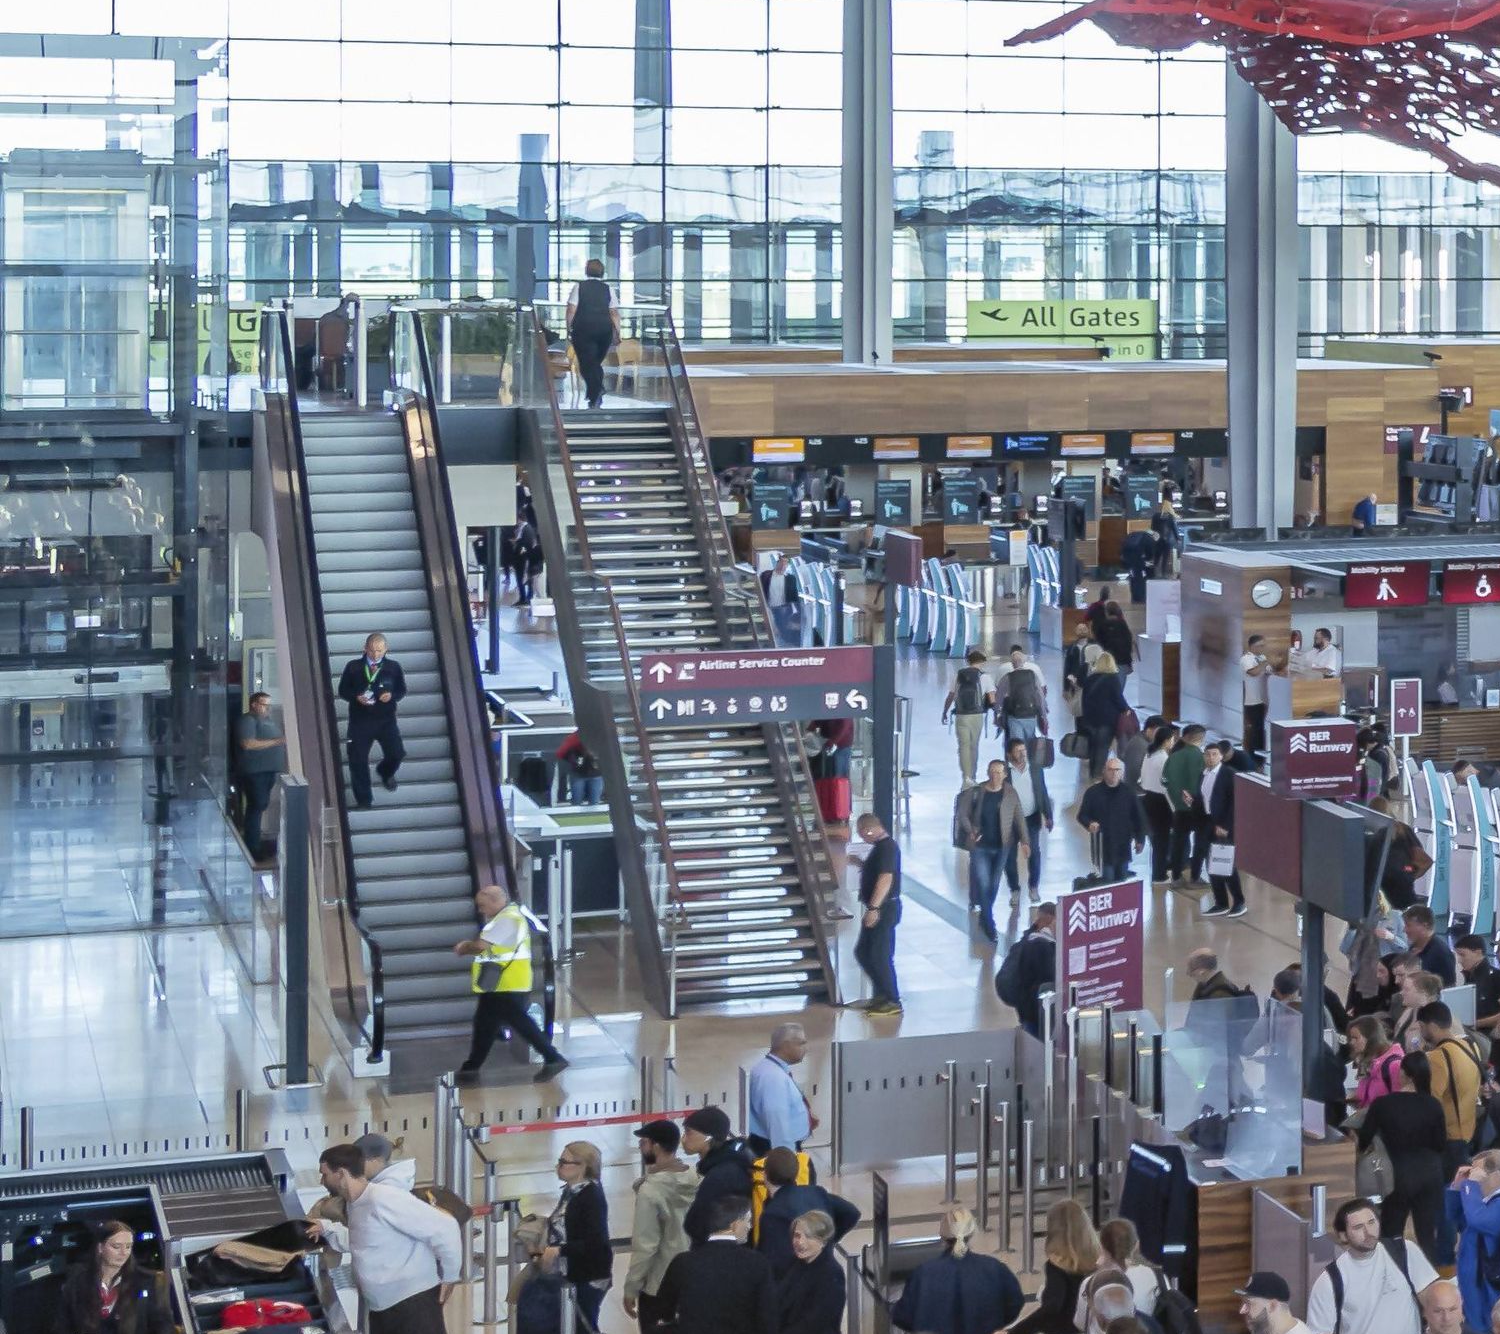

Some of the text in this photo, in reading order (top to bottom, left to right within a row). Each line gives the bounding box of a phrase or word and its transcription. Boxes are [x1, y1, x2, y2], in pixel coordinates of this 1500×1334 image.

[1022, 306, 1140, 327] All Gates
[1463, 387, 1471, 403] 1
[699, 656, 826, 670] Airline Service Counter
[1308, 731, 1331, 742] BER
[1309, 743, 1354, 754] Runway
[1088, 892, 1113, 913] BER
[1088, 907, 1139, 932] Runway
